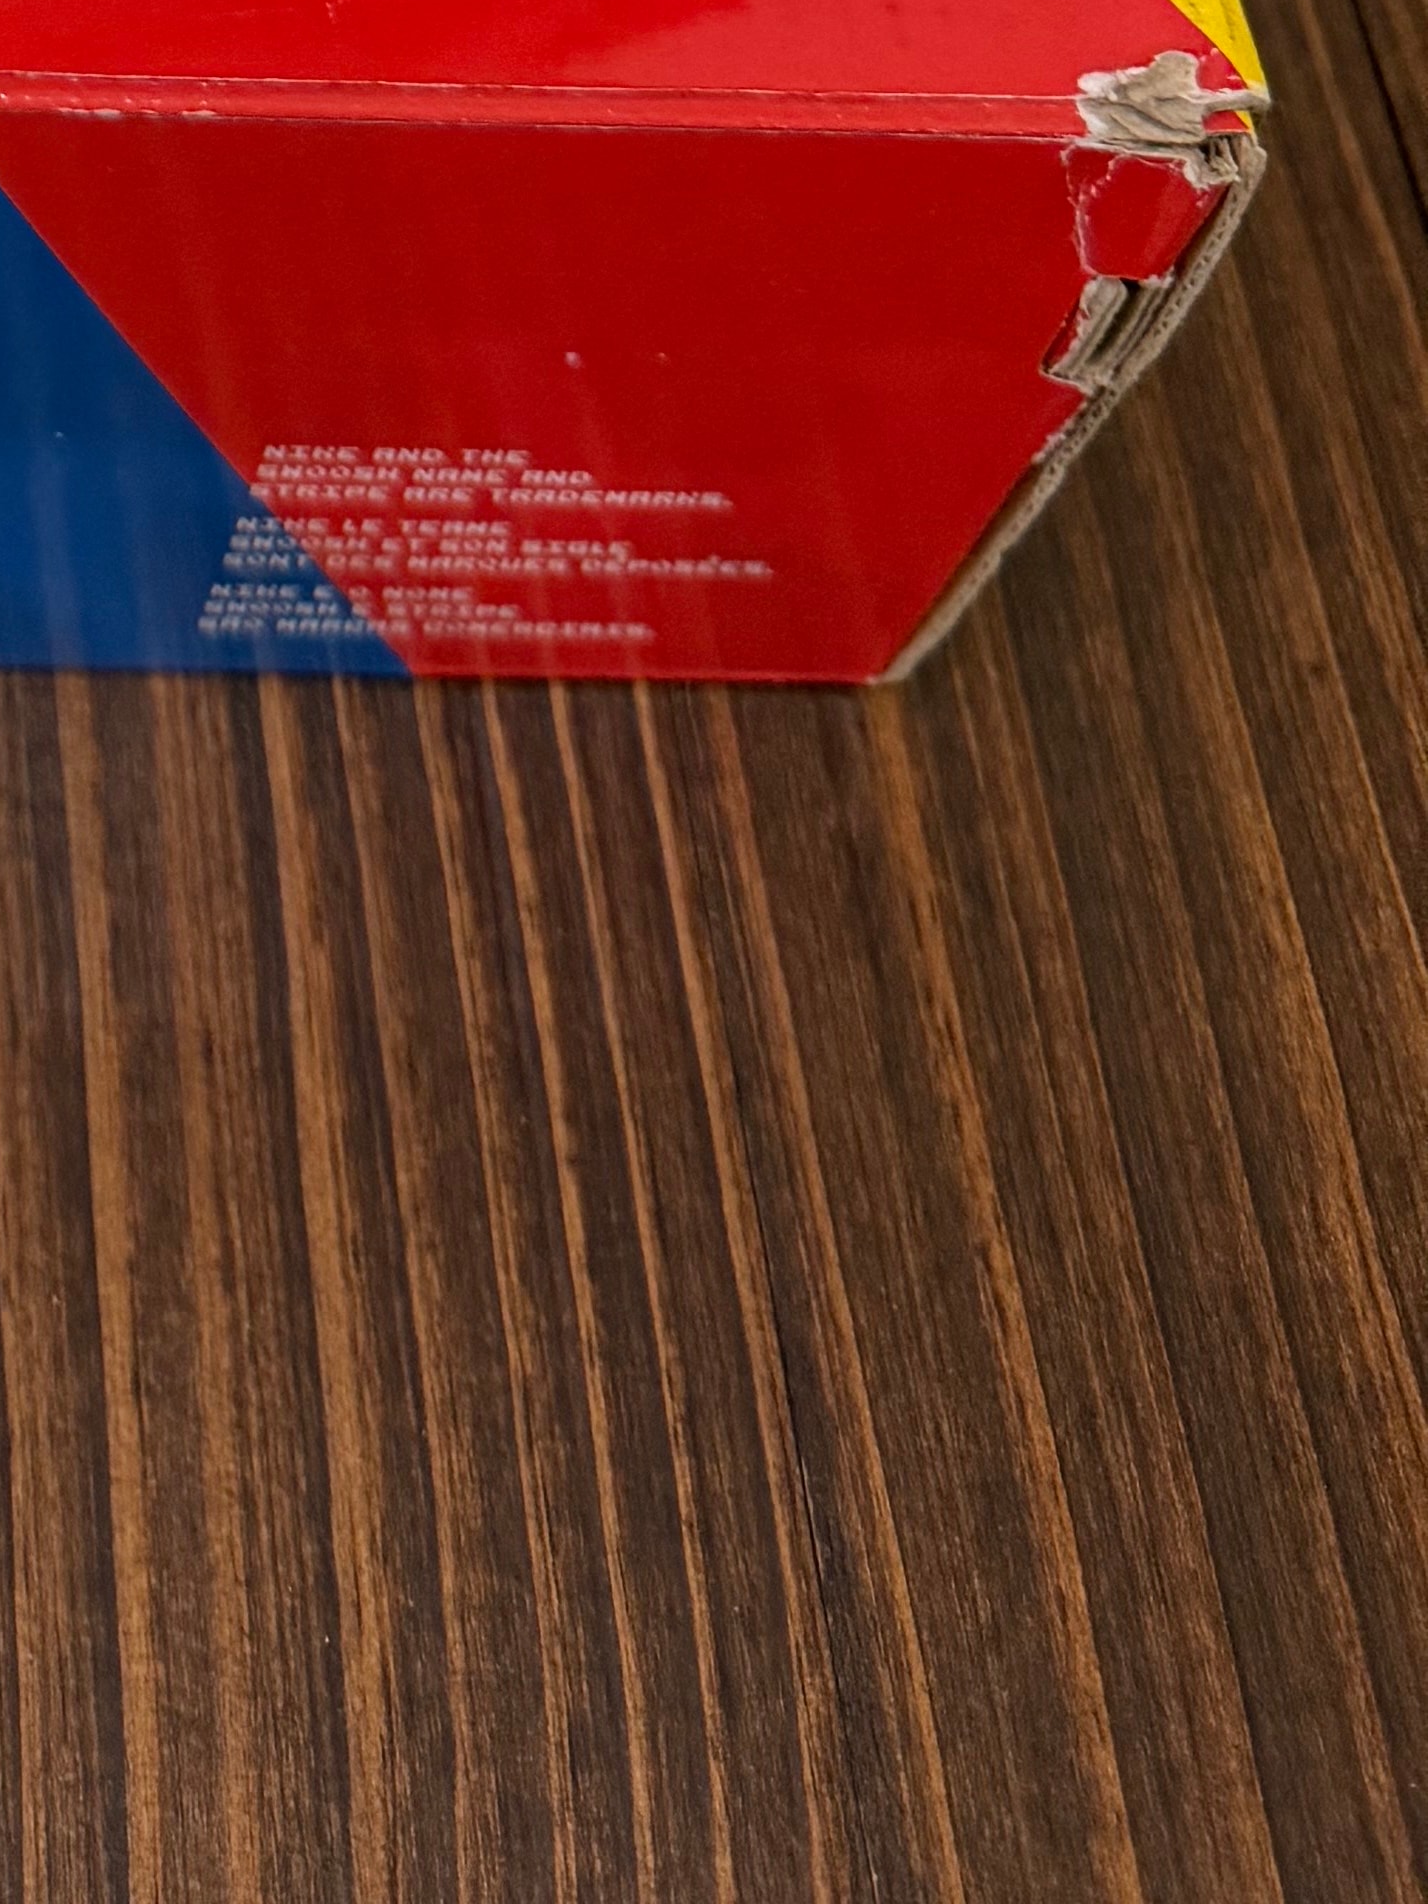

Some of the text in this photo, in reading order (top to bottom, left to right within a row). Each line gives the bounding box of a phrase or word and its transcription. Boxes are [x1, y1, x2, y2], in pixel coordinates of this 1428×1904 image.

[263, 445, 530, 465] NIKE AND THE
[520, 469, 593, 485] AND
[249, 483, 391, 500] STRIPE
